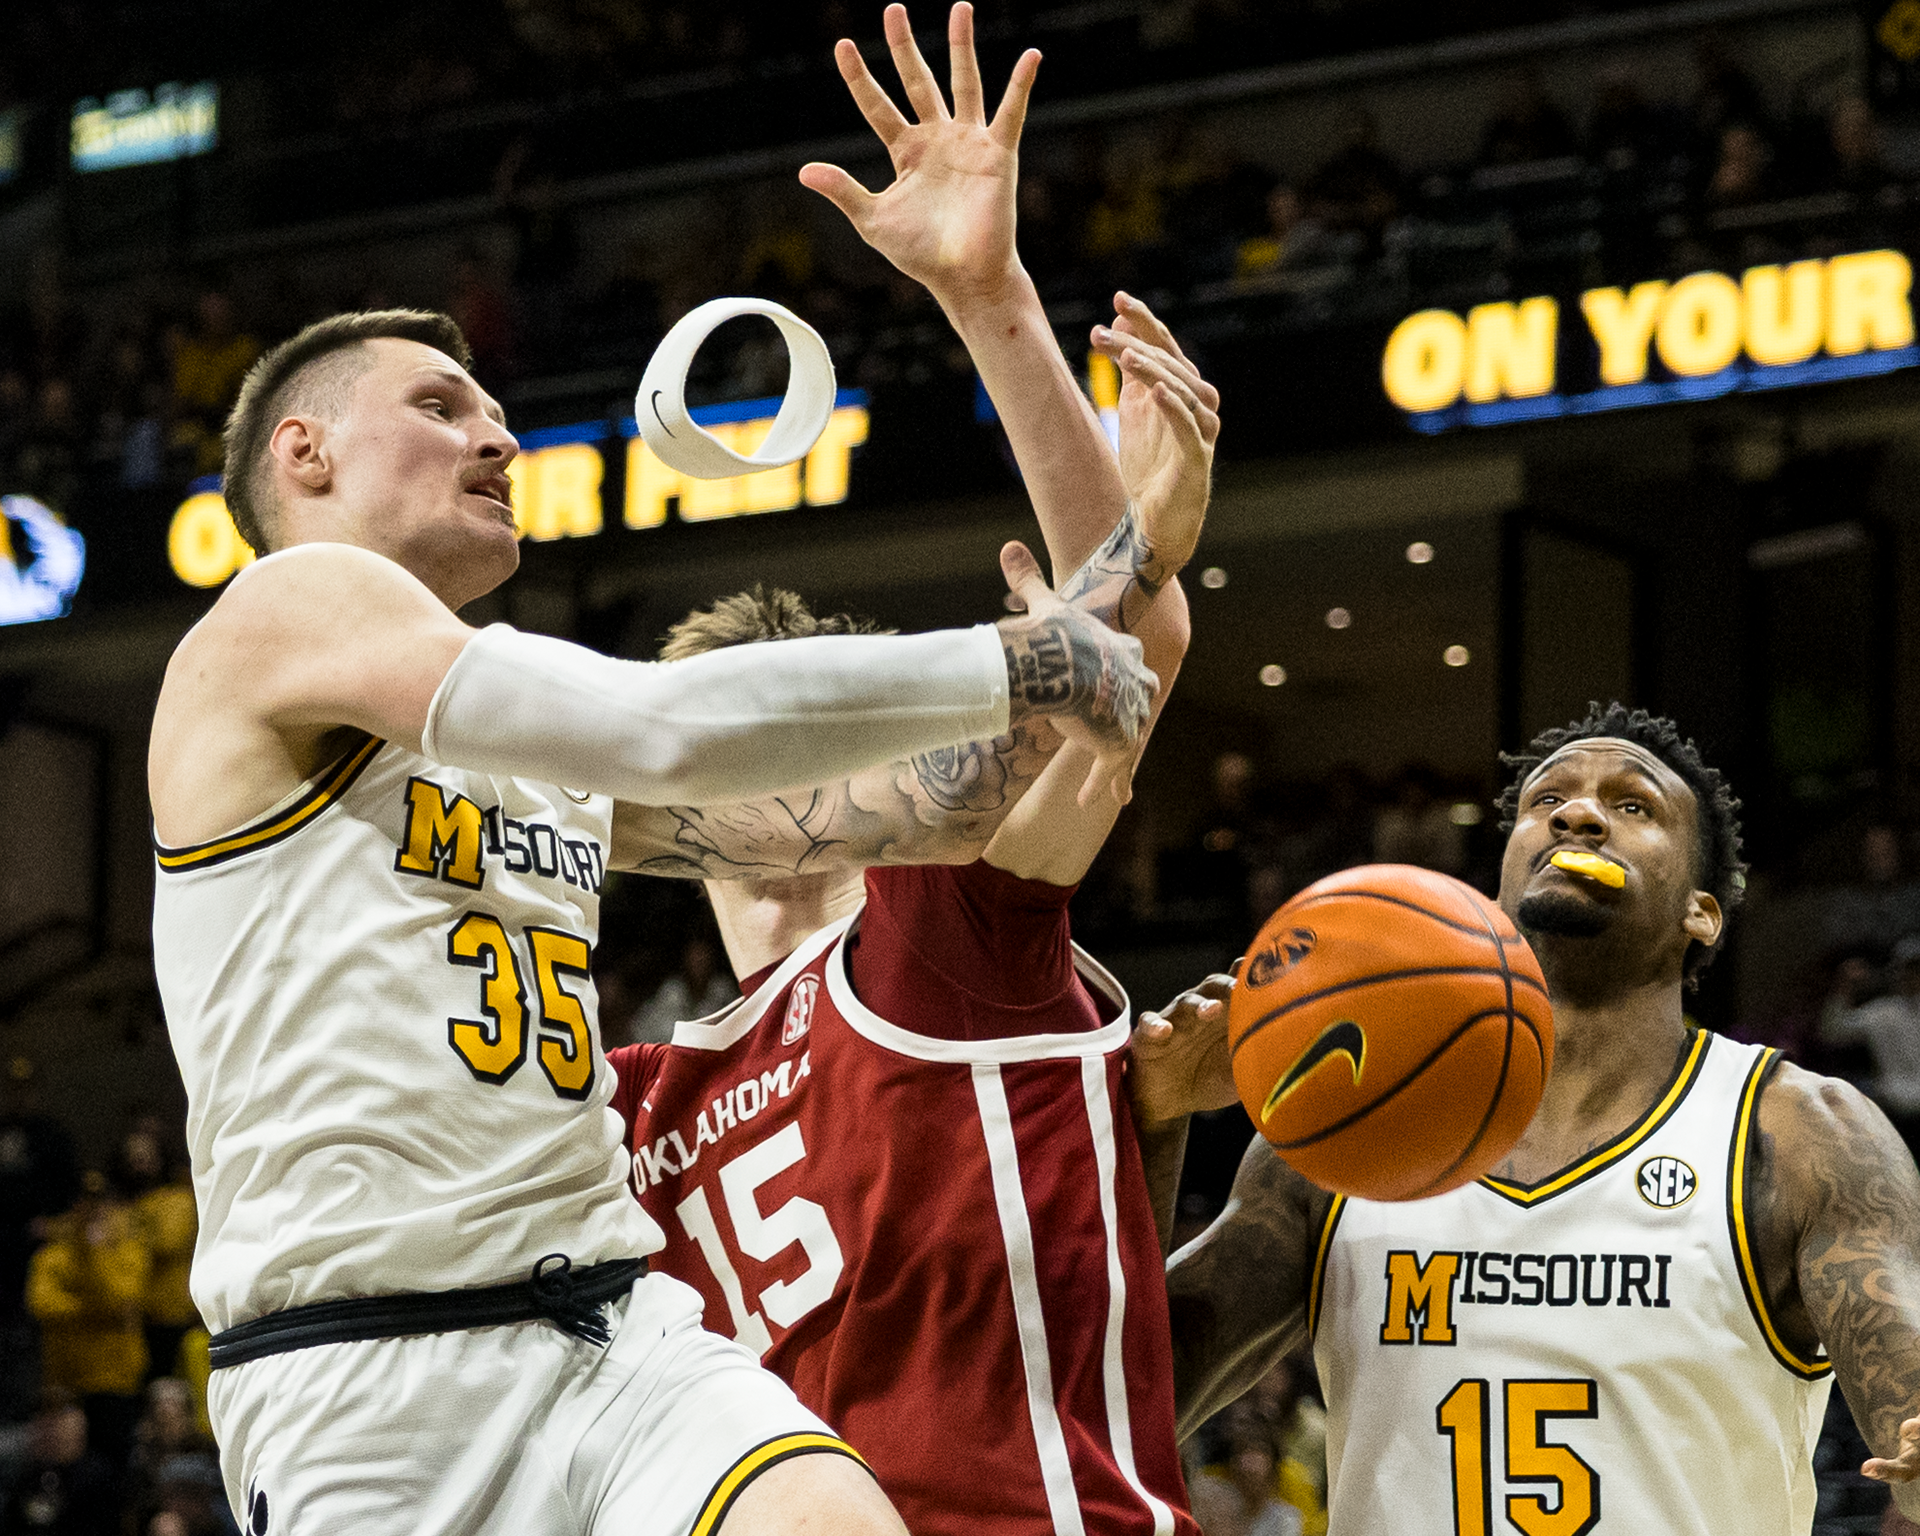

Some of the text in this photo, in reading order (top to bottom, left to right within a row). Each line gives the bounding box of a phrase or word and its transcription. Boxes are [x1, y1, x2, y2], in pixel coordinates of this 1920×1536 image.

[1383, 249, 1914, 414] ON YOUR
[167, 491, 257, 589] O
[447, 910, 596, 1102] 35
[675, 1120, 845, 1364] 15
[1641, 1157, 1694, 1206] SEC
[1379, 1250, 1672, 1346] MISSOURI
[1436, 1378, 1601, 1536] 15
